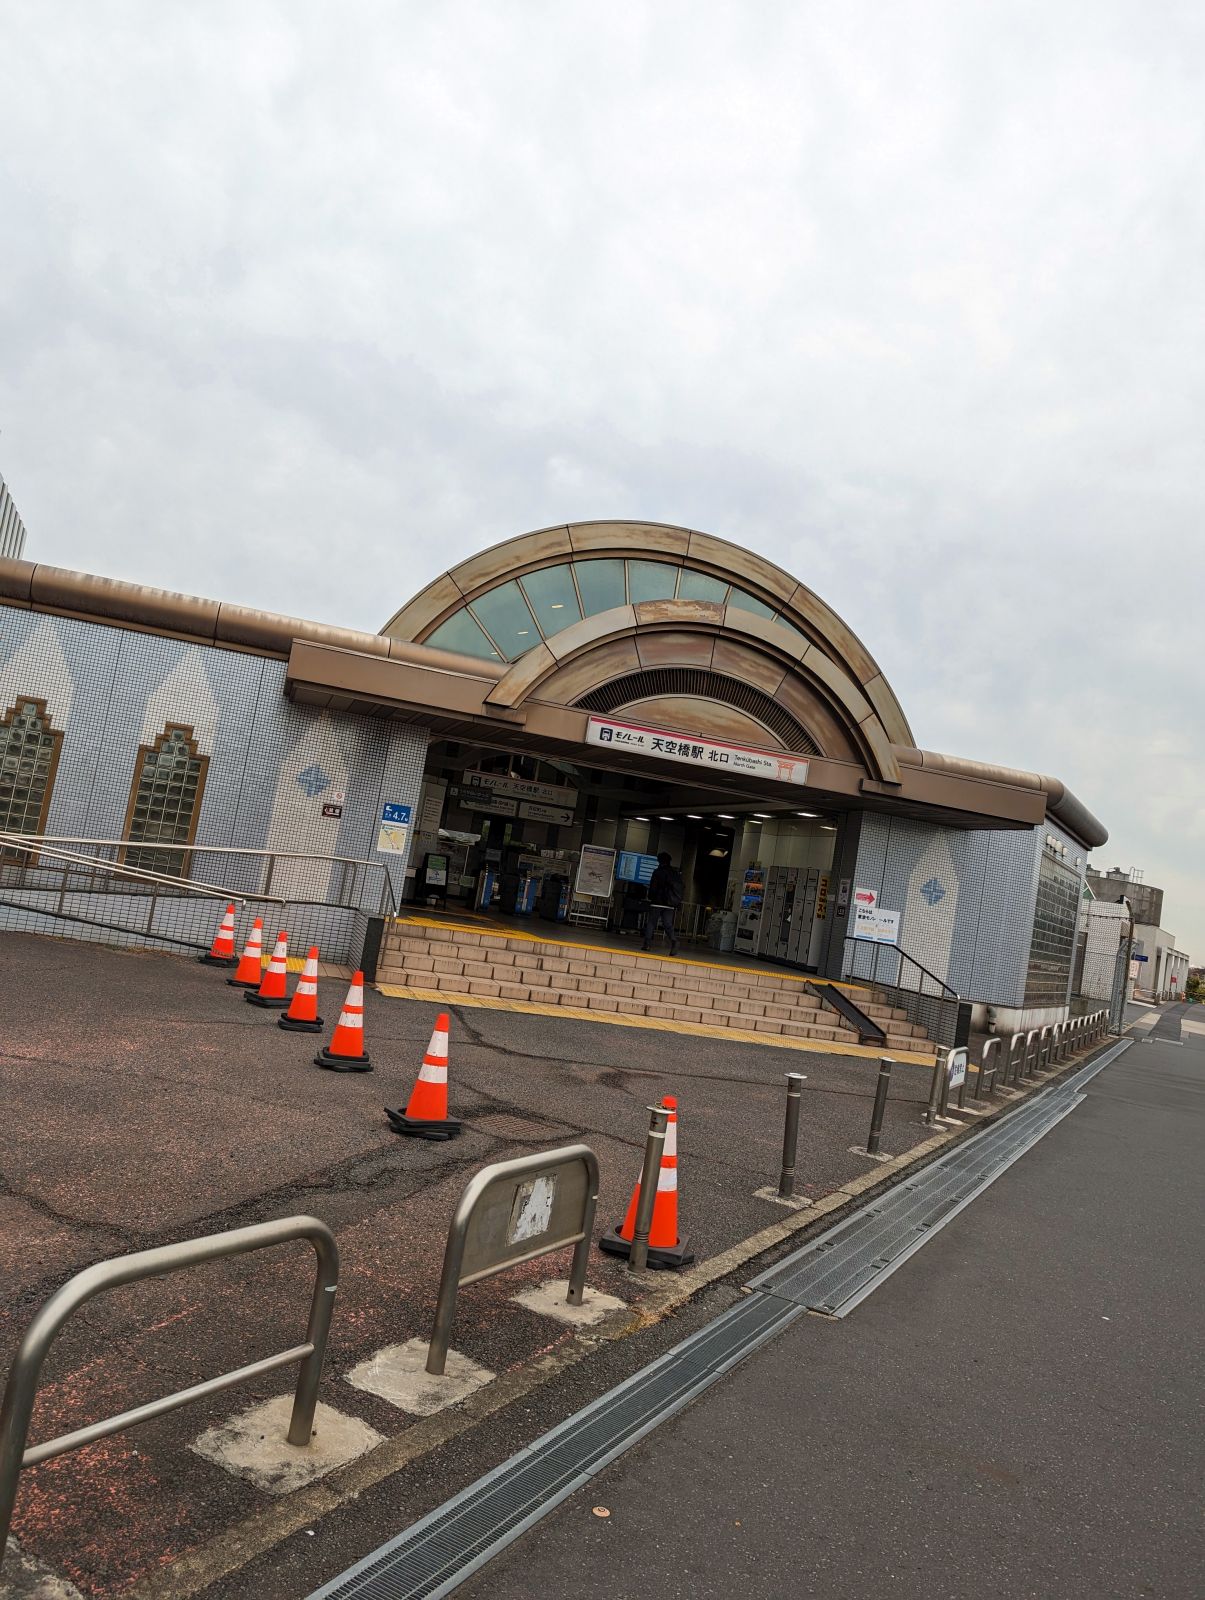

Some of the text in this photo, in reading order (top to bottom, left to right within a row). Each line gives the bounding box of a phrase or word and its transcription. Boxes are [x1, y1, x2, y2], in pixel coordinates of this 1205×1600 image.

[615, 731, 645, 743] モノレール
[651, 737, 729, 764] 天空橋駅 北口
